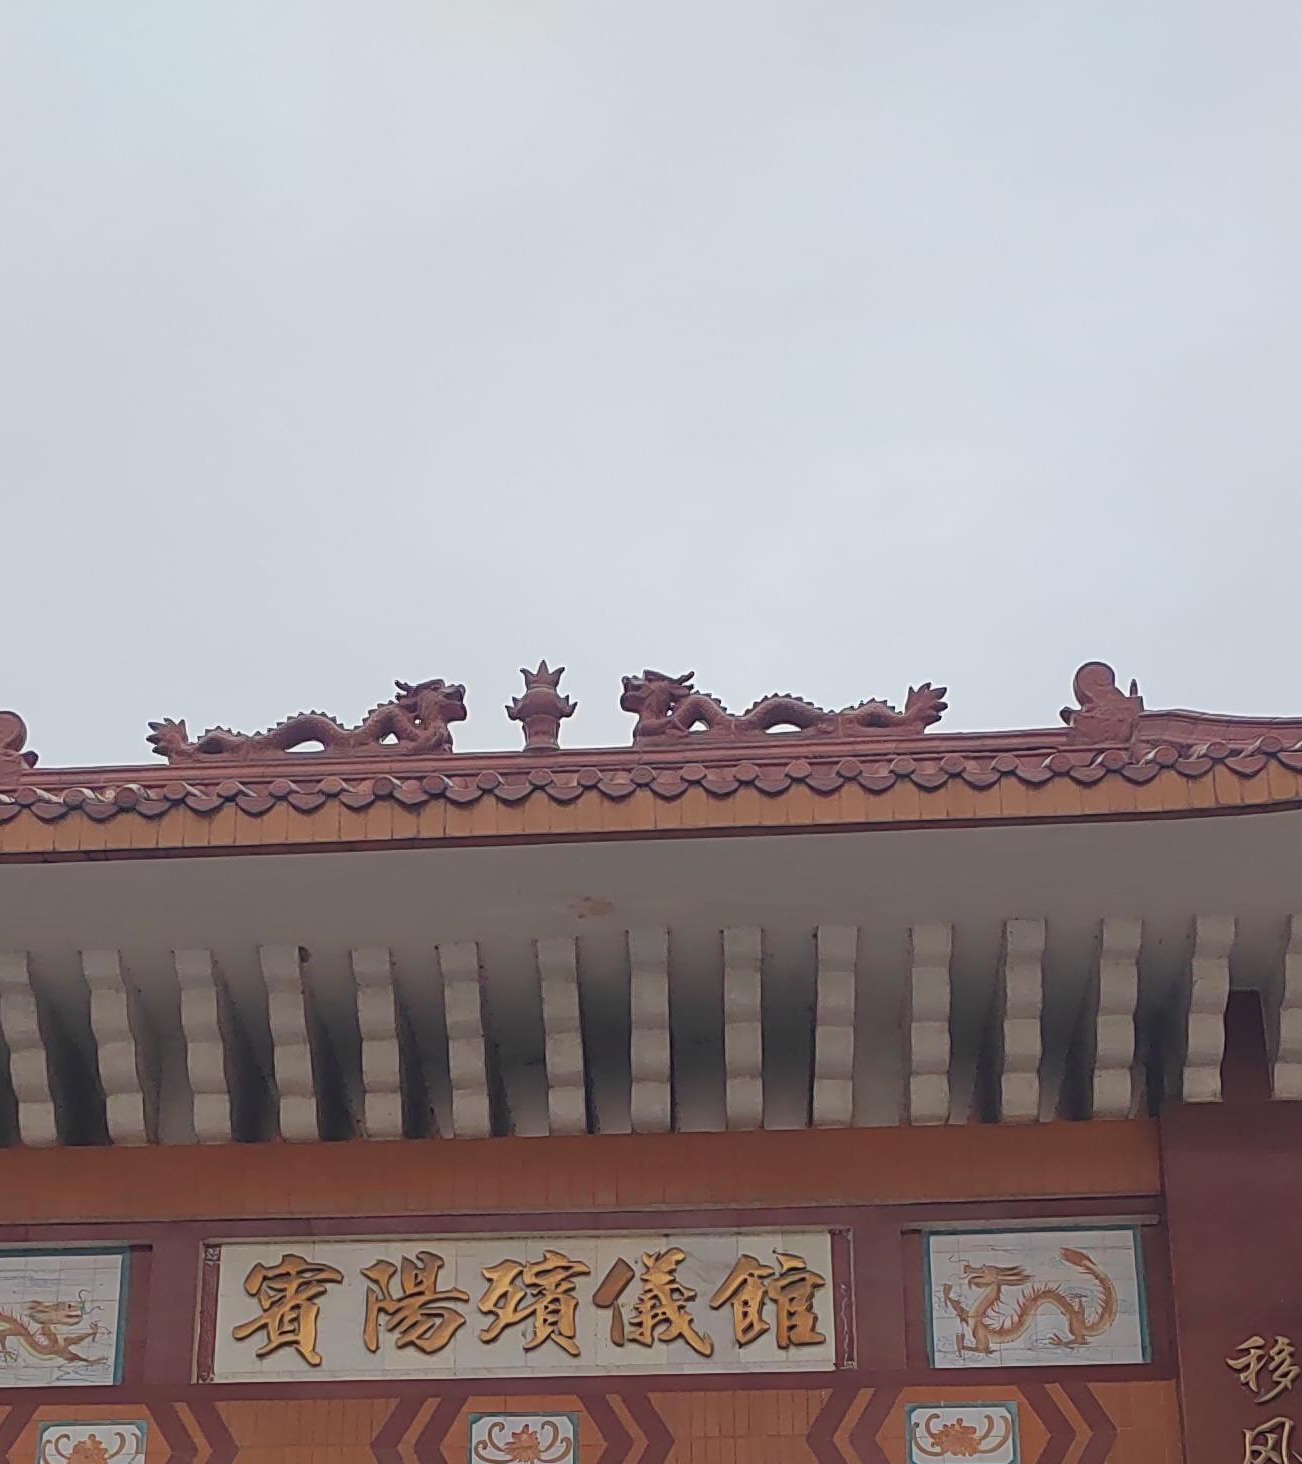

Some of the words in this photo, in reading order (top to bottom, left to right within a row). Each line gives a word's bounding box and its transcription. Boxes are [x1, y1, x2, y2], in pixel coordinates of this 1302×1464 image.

[233, 1245, 827, 1367] 賓陽殯儀館
